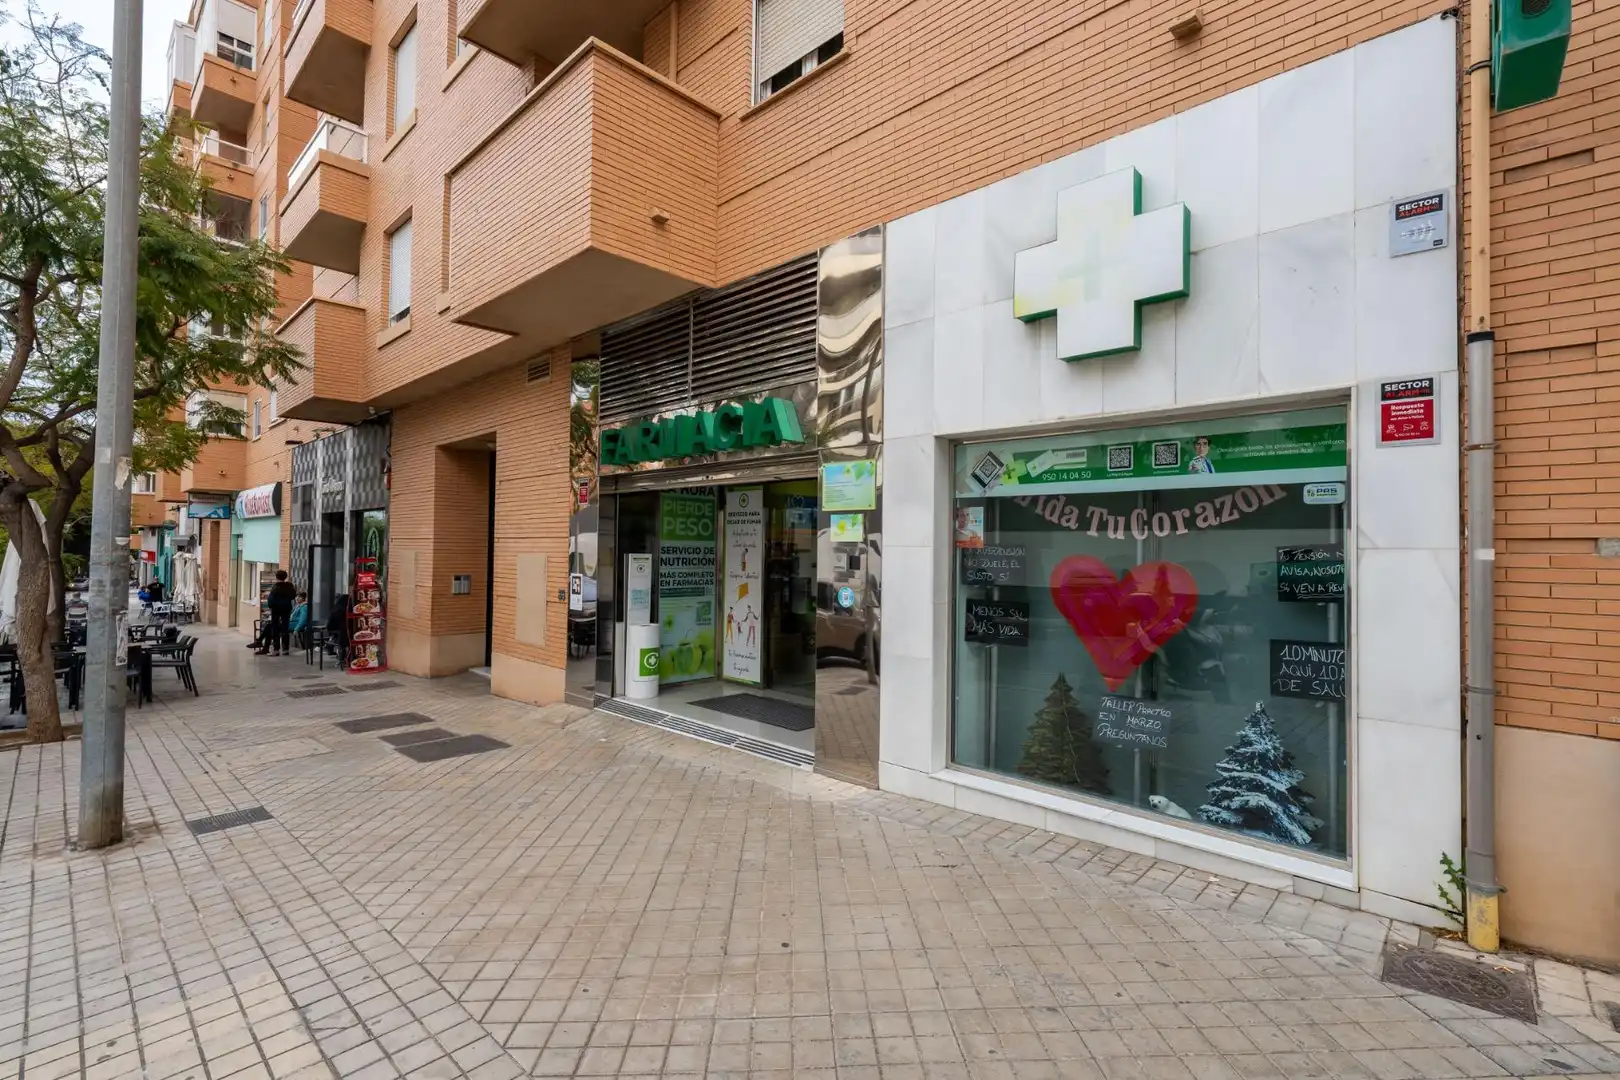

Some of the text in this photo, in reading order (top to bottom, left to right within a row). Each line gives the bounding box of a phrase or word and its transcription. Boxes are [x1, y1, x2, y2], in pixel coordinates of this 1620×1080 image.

[1399, 197, 1440, 212] SECTOR
[1399, 206, 1431, 217] ALARM
[1384, 380, 1430, 392] SECTOR
[1390, 403, 1424, 411] Respuesta
[600, 397, 803, 465] FARMACIA
[1042, 471, 1092, 481] 950 14 04 50
[663, 500, 713, 516] PIERDE
[663, 516, 713, 537] PESO
[1086, 505, 1125, 540] Tu
[660, 546, 715, 555] SERVICIO DE
[1010, 560, 1020, 568] EL
[660, 570, 714, 579] MÁS COMPLETO
[967, 570, 994, 581] SUSTO
[1293, 582, 1315, 593] VEN
[972, 604, 1004, 616] MENOS
[1301, 646, 1345, 664] MINUTO
[1317, 664, 1338, 681] 10
[1273, 678, 1302, 692] DE
[1101, 696, 1135, 712] TALLER
[1098, 711, 1116, 721] EN
